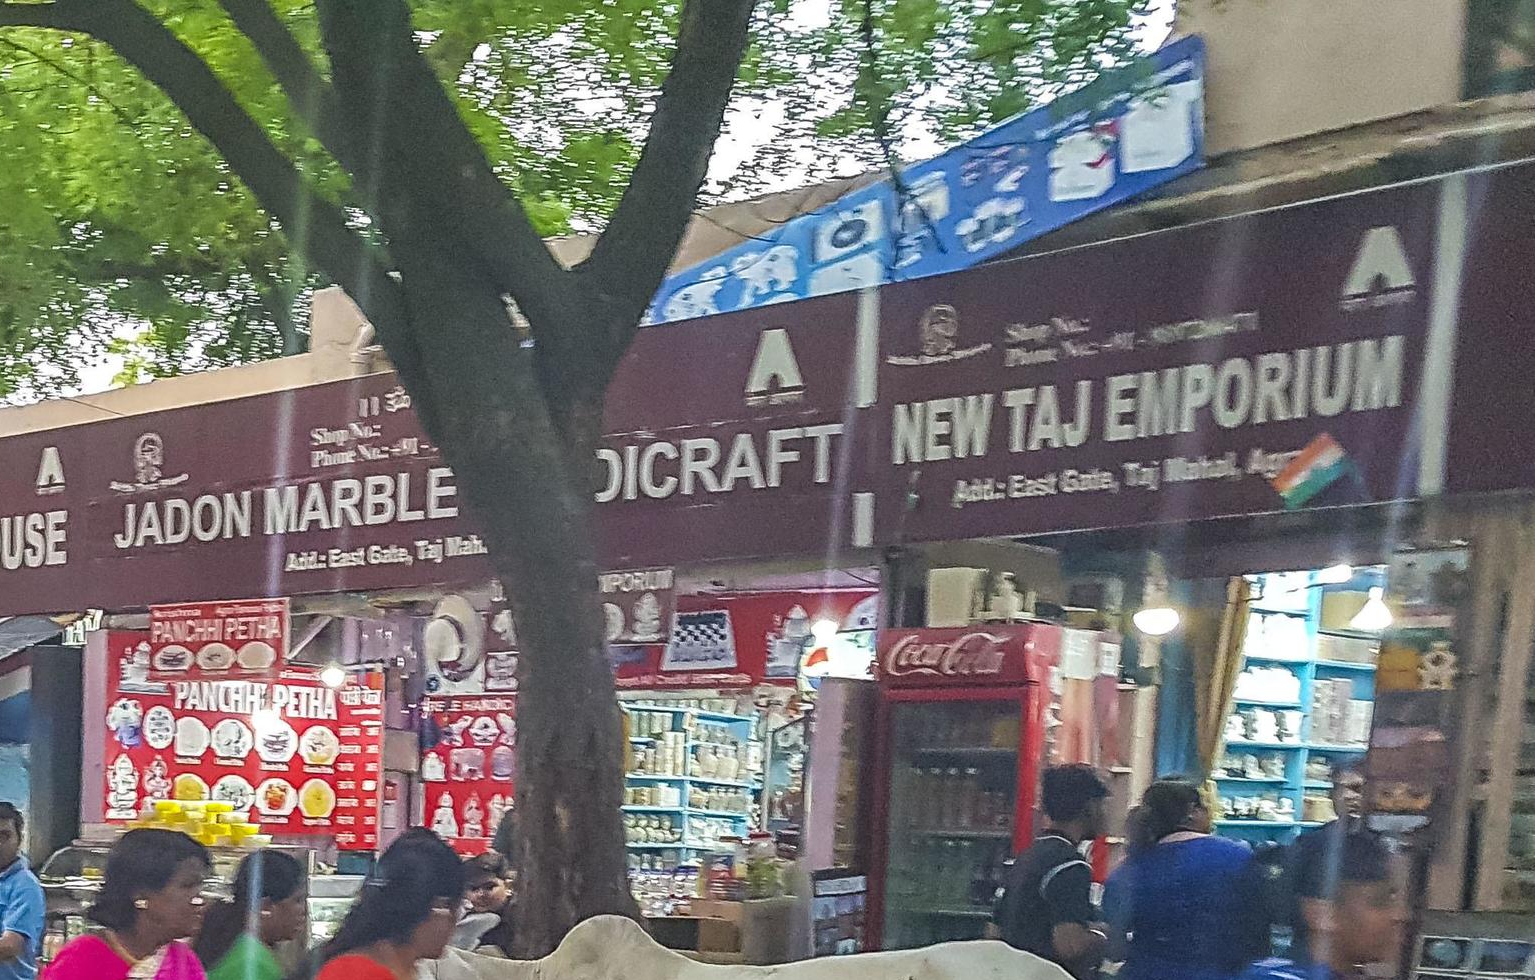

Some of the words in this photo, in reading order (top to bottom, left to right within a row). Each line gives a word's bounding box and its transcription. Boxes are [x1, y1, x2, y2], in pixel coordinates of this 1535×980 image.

[892, 393, 993, 465] NEW
[1003, 379, 1091, 453] TAJ
[1104, 335, 1405, 443] EMPORIUM
[114, 490, 251, 549] JADON
[264, 467, 459, 535] MARBLE
[595, 423, 845, 502] DICRAFT
[327, 546, 366, 568] East
[414, 538, 444, 563] Taj
[152, 619, 223, 643] PANCHHI
[225, 615, 281, 640] PETHA
[173, 681, 267, 715] PANCHHI
[272, 685, 338, 720] PETHA
